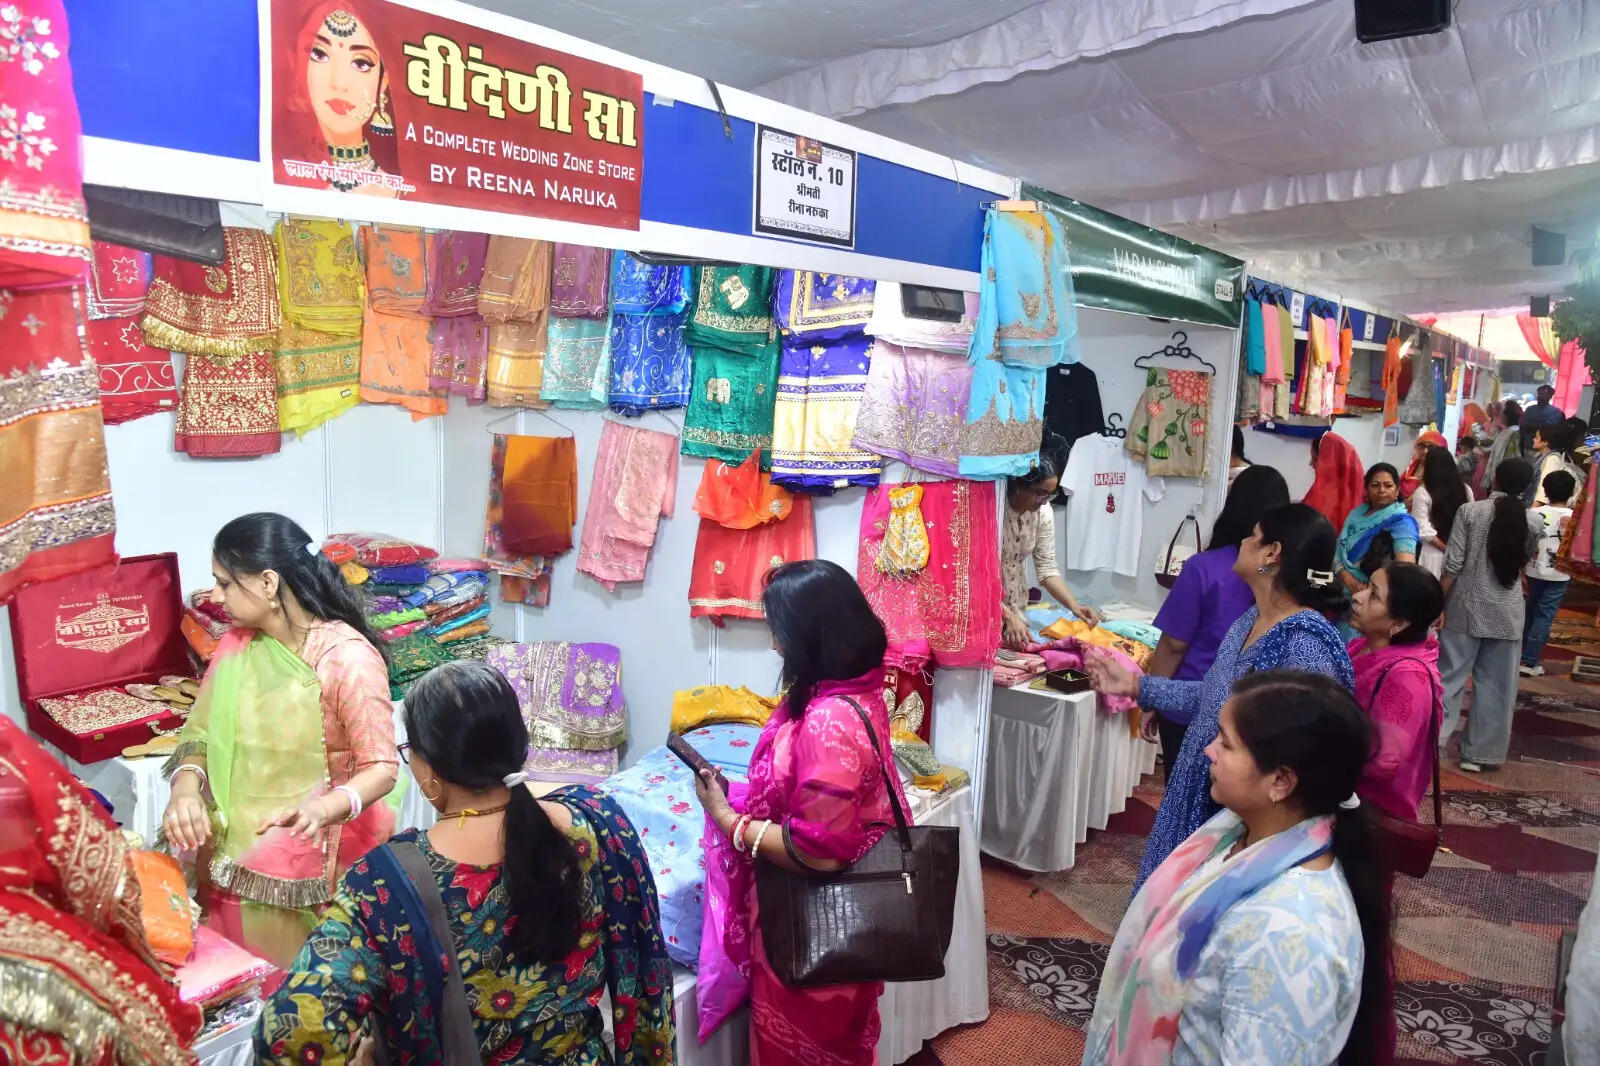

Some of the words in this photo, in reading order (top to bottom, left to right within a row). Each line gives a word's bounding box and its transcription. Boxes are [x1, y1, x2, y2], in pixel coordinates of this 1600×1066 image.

[402, 33, 573, 134] बींदणी
[582, 89, 638, 147] सा
[405, 122, 417, 142] A
[423, 125, 496, 157] COMPLETE
[501, 140, 558, 167] WEDDING
[563, 152, 593, 174] ZONE
[598, 159, 635, 181] STORE
[771, 149, 805, 177] स्टॉल
[828, 167, 844, 186] 10
[430, 164, 457, 184] BY
[467, 166, 536, 197] REENA
[544, 179, 618, 209] NARUKA
[788, 199, 805, 214] रीना
[796, 183, 821, 199] श्रीमती
